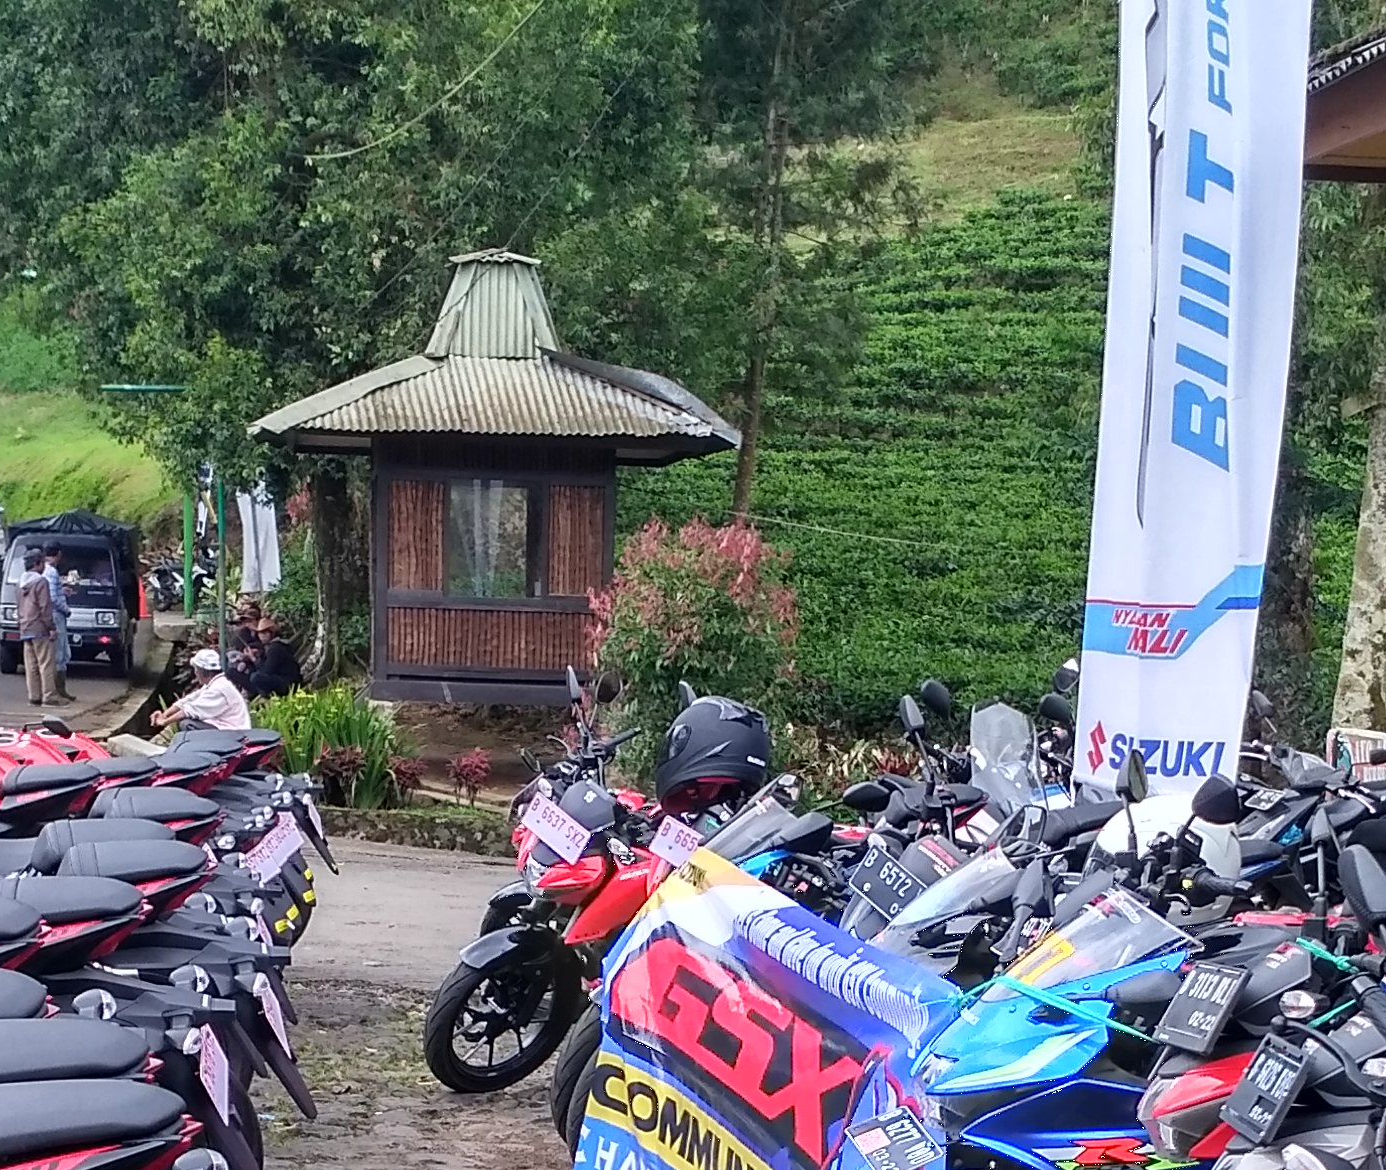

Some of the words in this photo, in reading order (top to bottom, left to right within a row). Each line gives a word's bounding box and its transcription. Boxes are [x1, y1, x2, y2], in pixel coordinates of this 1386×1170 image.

[530, 798, 541, 812] B
[541, 805, 566, 831] 6637
[564, 824, 585, 848] SXZ
[661, 821, 671, 836] B
[864, 850, 878, 868] B
[879, 861, 912, 898] 6572
[610, 937, 864, 1166] GSX
